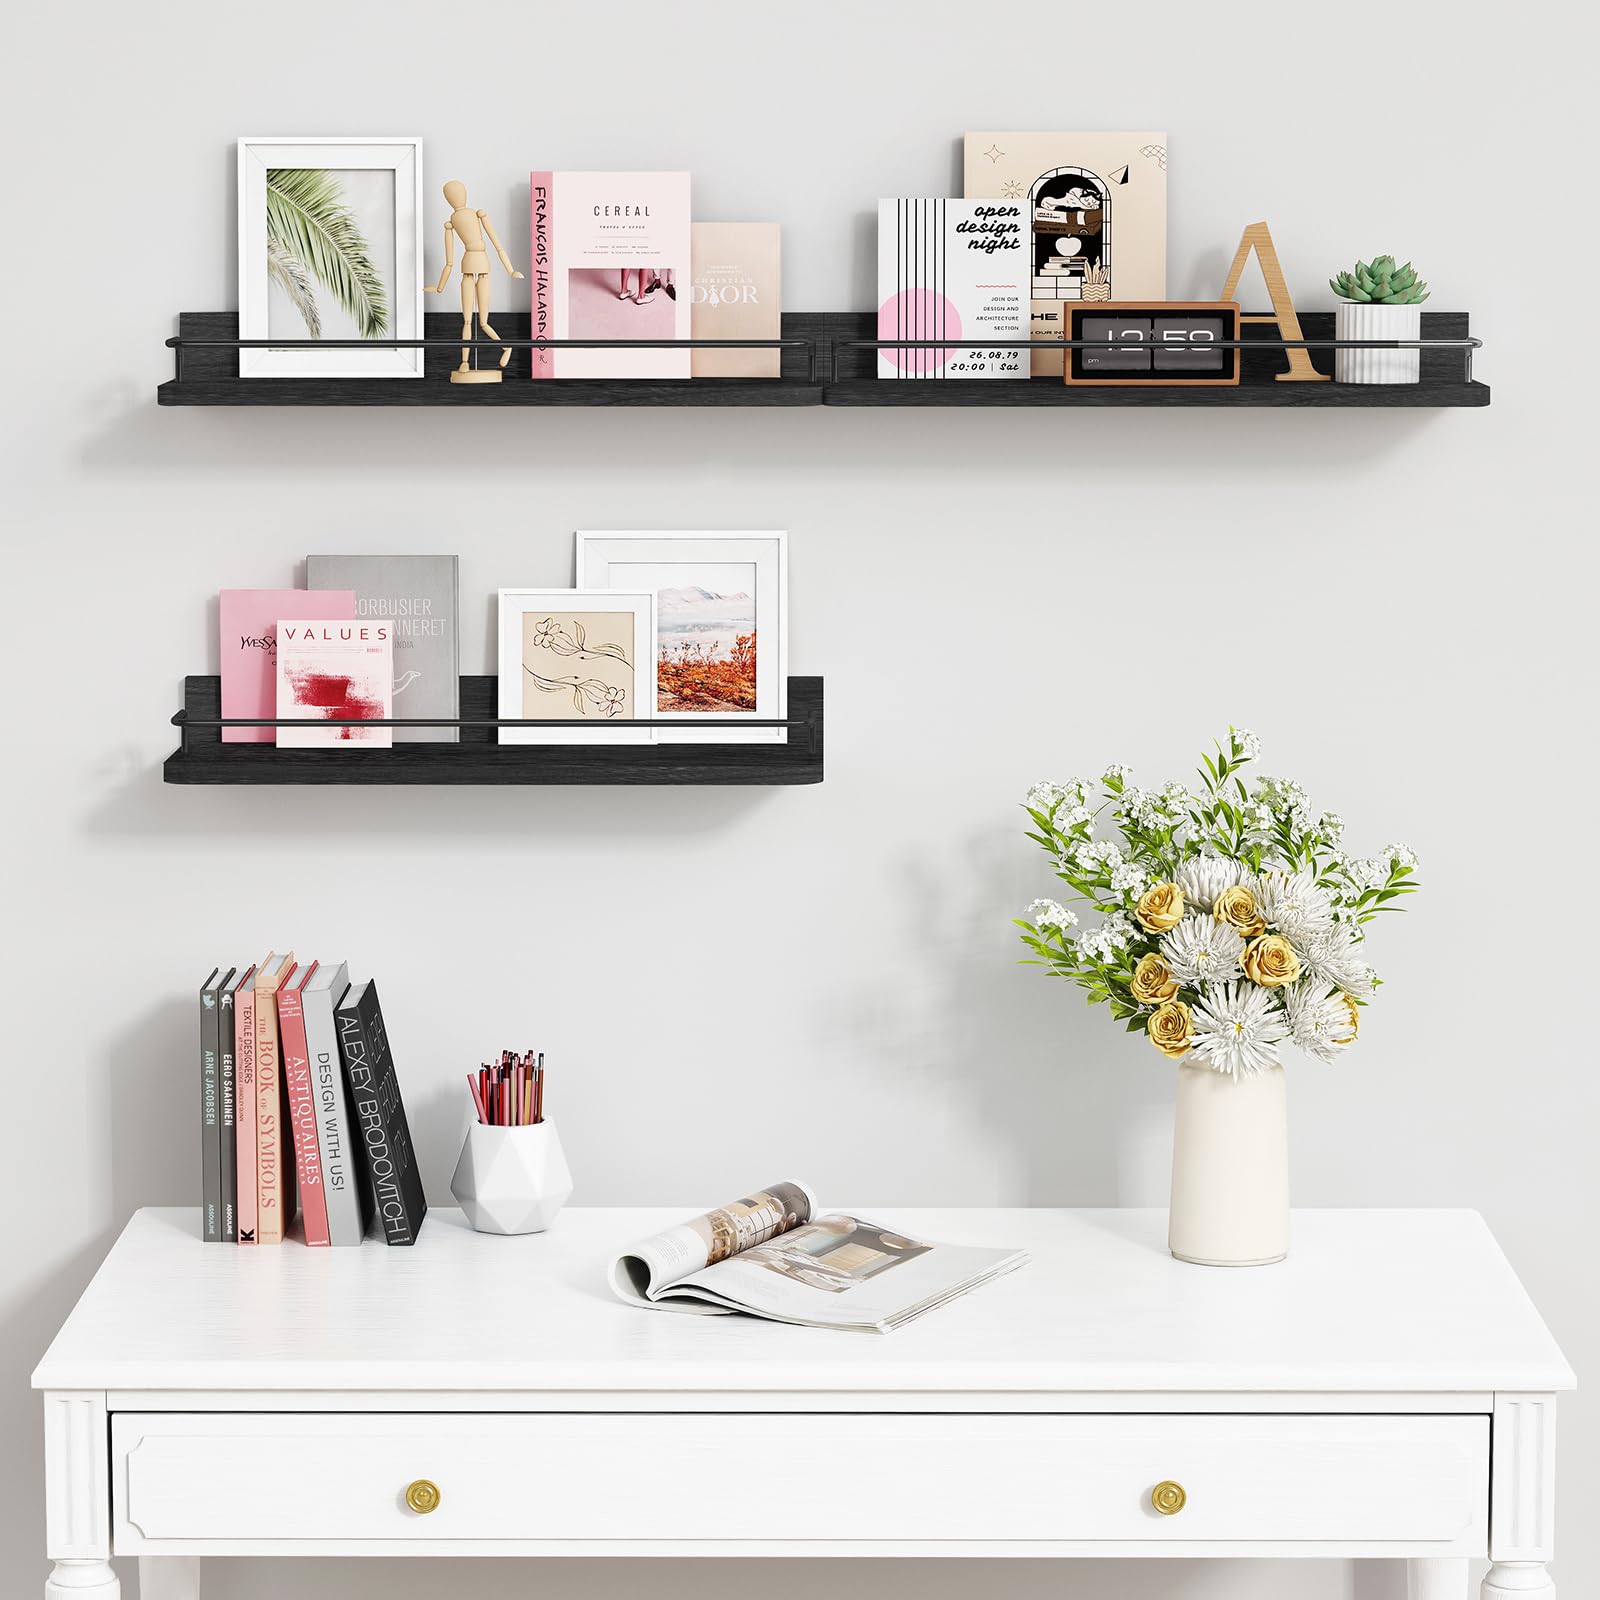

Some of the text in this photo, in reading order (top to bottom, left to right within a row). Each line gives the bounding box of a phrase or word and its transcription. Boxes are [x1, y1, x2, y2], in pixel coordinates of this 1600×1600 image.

[593, 205, 650, 217] CEREAL
[956, 220, 1021, 238] design
[974, 206, 1021, 221] open
[968, 236, 1021, 254] night
[536, 269, 548, 333] HALARD
[950, 363, 985, 371] 20:00
[999, 363, 1019, 371] Sat
[969, 351, 1019, 360] 26.08.19
[285, 628, 387, 640] VALUES
[243, 1005, 253, 1084] TEXTILE DESIGNERS
[259, 1040, 274, 1093] BOOK
[205, 1051, 215, 1125] ARNE JACOBSEN
[223, 1054, 233, 1126] EERO SAARINEN
[293, 1056, 320, 1185] ANTIQUAIRES
[317, 1052, 345, 1191] DESIGN WITH US!
[337, 1016, 375, 1093] ALEXEY
[358, 1099, 407, 1234] BRODOVITCH
[260, 1114, 276, 1208] SYMBOLS
[240, 1228, 254, 1241] K
